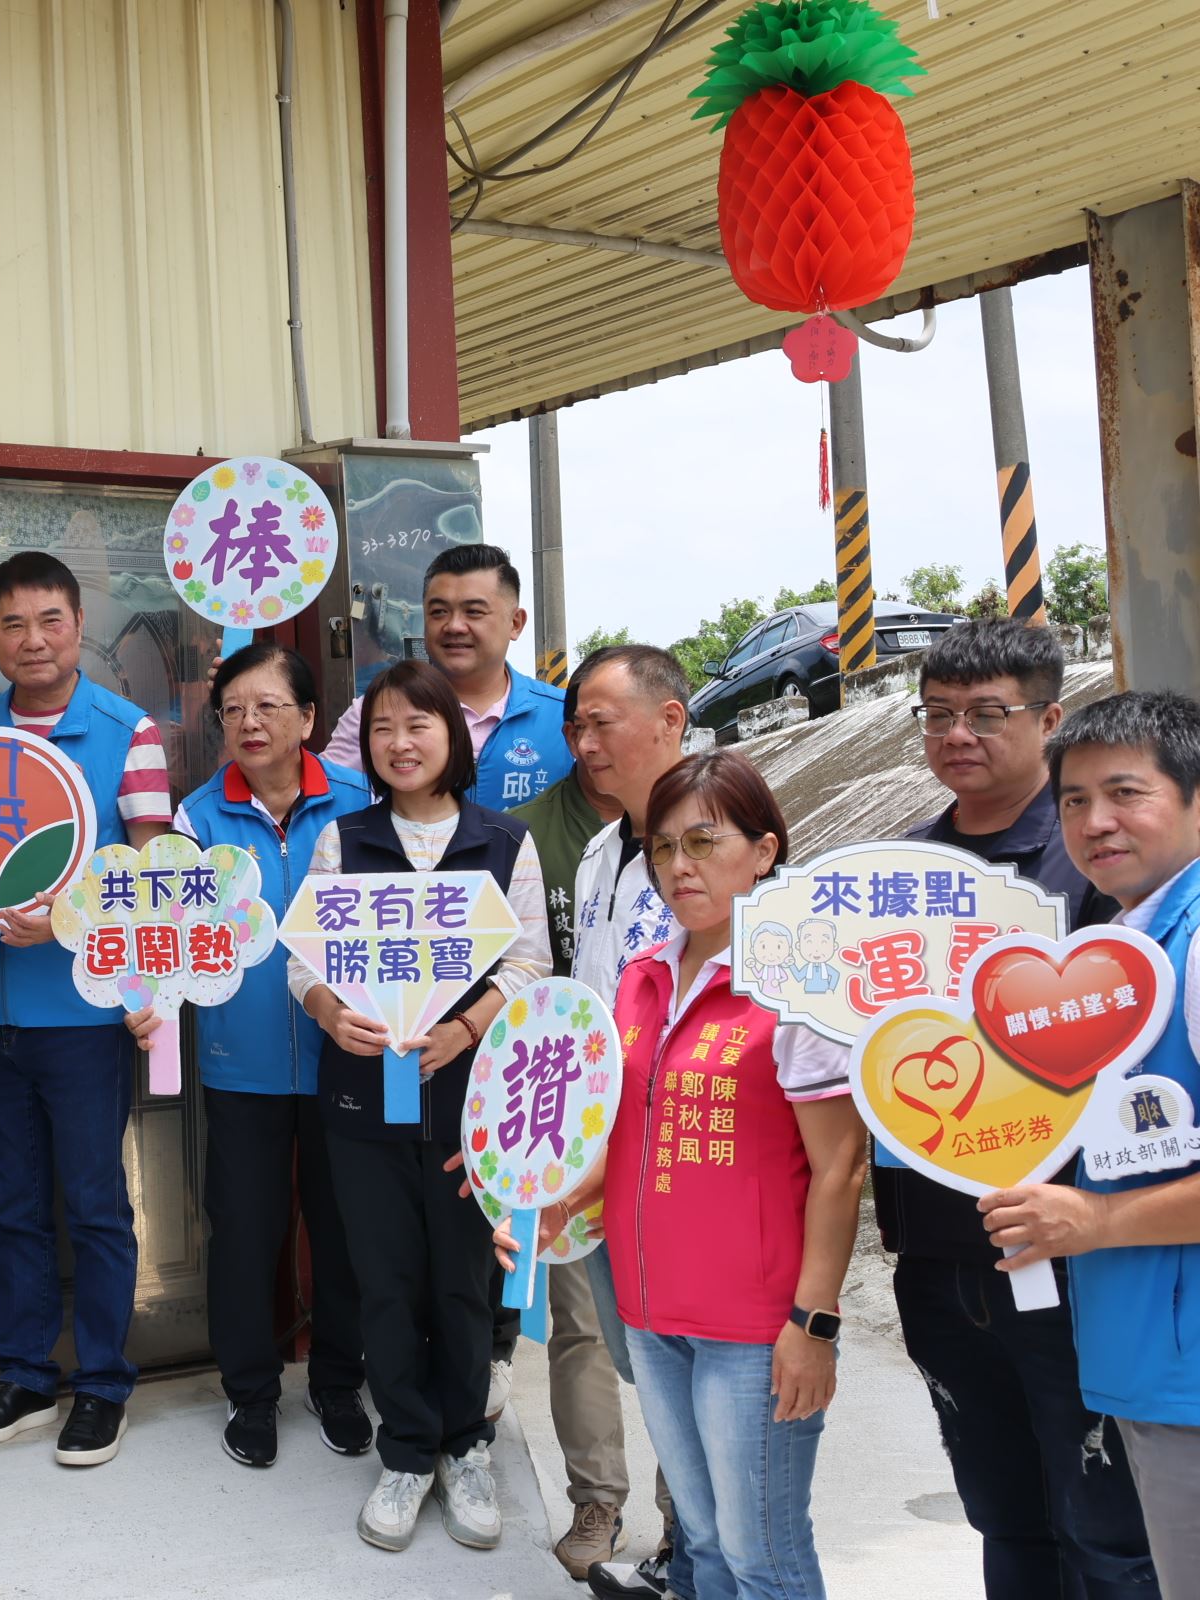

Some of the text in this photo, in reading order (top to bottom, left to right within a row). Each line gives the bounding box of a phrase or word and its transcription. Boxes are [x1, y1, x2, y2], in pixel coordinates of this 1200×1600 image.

[201, 499, 298, 595] 棒
[502, 771, 531, 811] 邱
[101, 866, 218, 911] 共下來
[315, 883, 469, 932] 家有老
[810, 871, 977, 918] 來據點
[84, 924, 237, 977] 逗鬧熱
[325, 936, 474, 985] 勝萬寶
[497, 1034, 583, 1161] 讚
[676, 1022, 721, 1165] 議員 鄭秋風
[708, 1025, 750, 1167] 立委 陳超明
[654, 1071, 679, 1194] 聯合服務處
[951, 1114, 1054, 1158] 公益彩券
